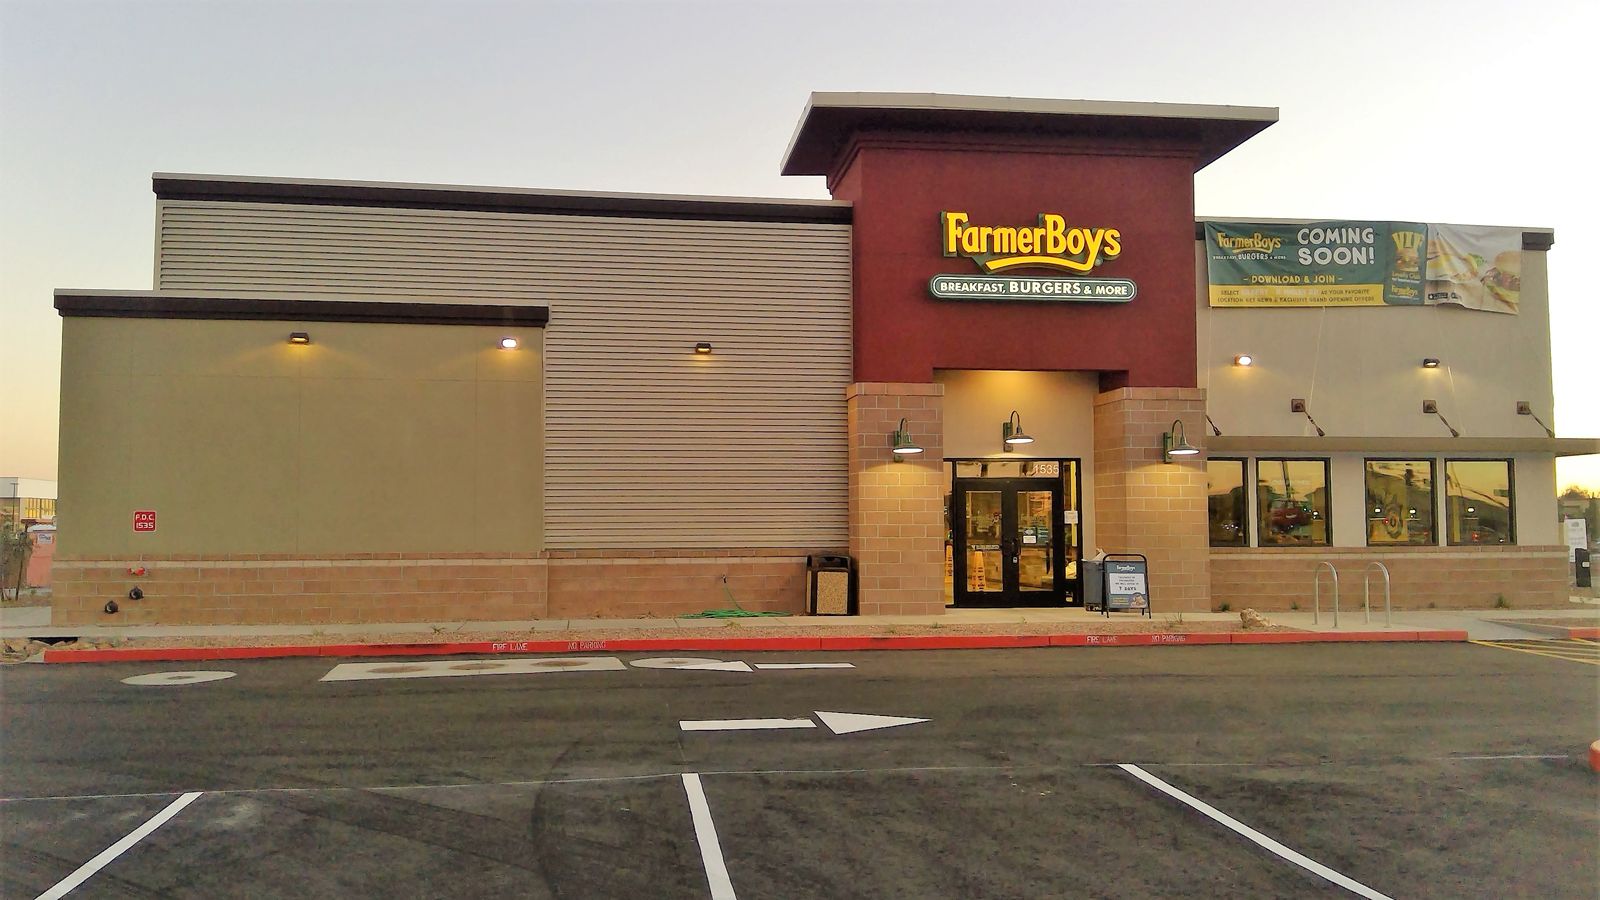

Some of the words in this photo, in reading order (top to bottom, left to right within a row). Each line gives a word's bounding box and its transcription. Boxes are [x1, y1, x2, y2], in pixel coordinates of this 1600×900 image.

[1297, 227, 1374, 245] COMING
[1298, 246, 1375, 265] SOON!
[1251, 275, 1300, 284] DOWNLOAD
[1304, 275, 1310, 284] &
[1313, 275, 1335, 283] JOIN
[940, 282, 1006, 294] BREAKFAST,
[1009, 281, 1081, 294] BURGERS
[1083, 285, 1092, 295] &
[1095, 285, 1128, 295] MORE
[1033, 464, 1059, 475] 1535
[1086, 635, 1100, 643] FIRE
[1102, 635, 1118, 643] LANE
[492, 643, 507, 651] FIRE
[510, 642, 528, 651] LANE
[568, 642, 577, 650] NO
[580, 641, 605, 649] PARKING
